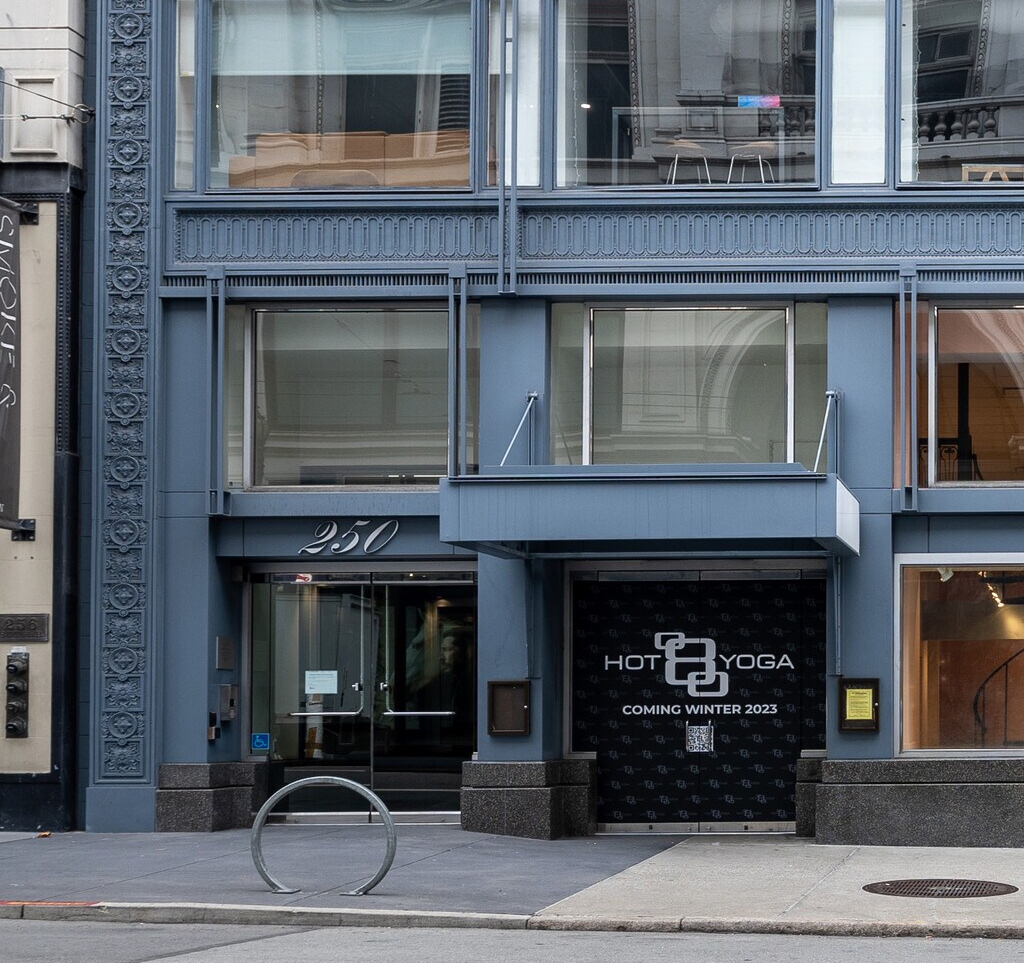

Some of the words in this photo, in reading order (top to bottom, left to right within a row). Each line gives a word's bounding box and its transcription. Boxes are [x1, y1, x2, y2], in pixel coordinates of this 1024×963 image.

[297, 519, 399, 554] 250
[5, 617, 38, 630] 256
[604, 654, 661, 670] HOT
[719, 654, 795, 669] YOGA
[622, 704, 681, 715] COMING
[685, 704, 741, 715] WINTER
[745, 704, 778, 714] 2023
